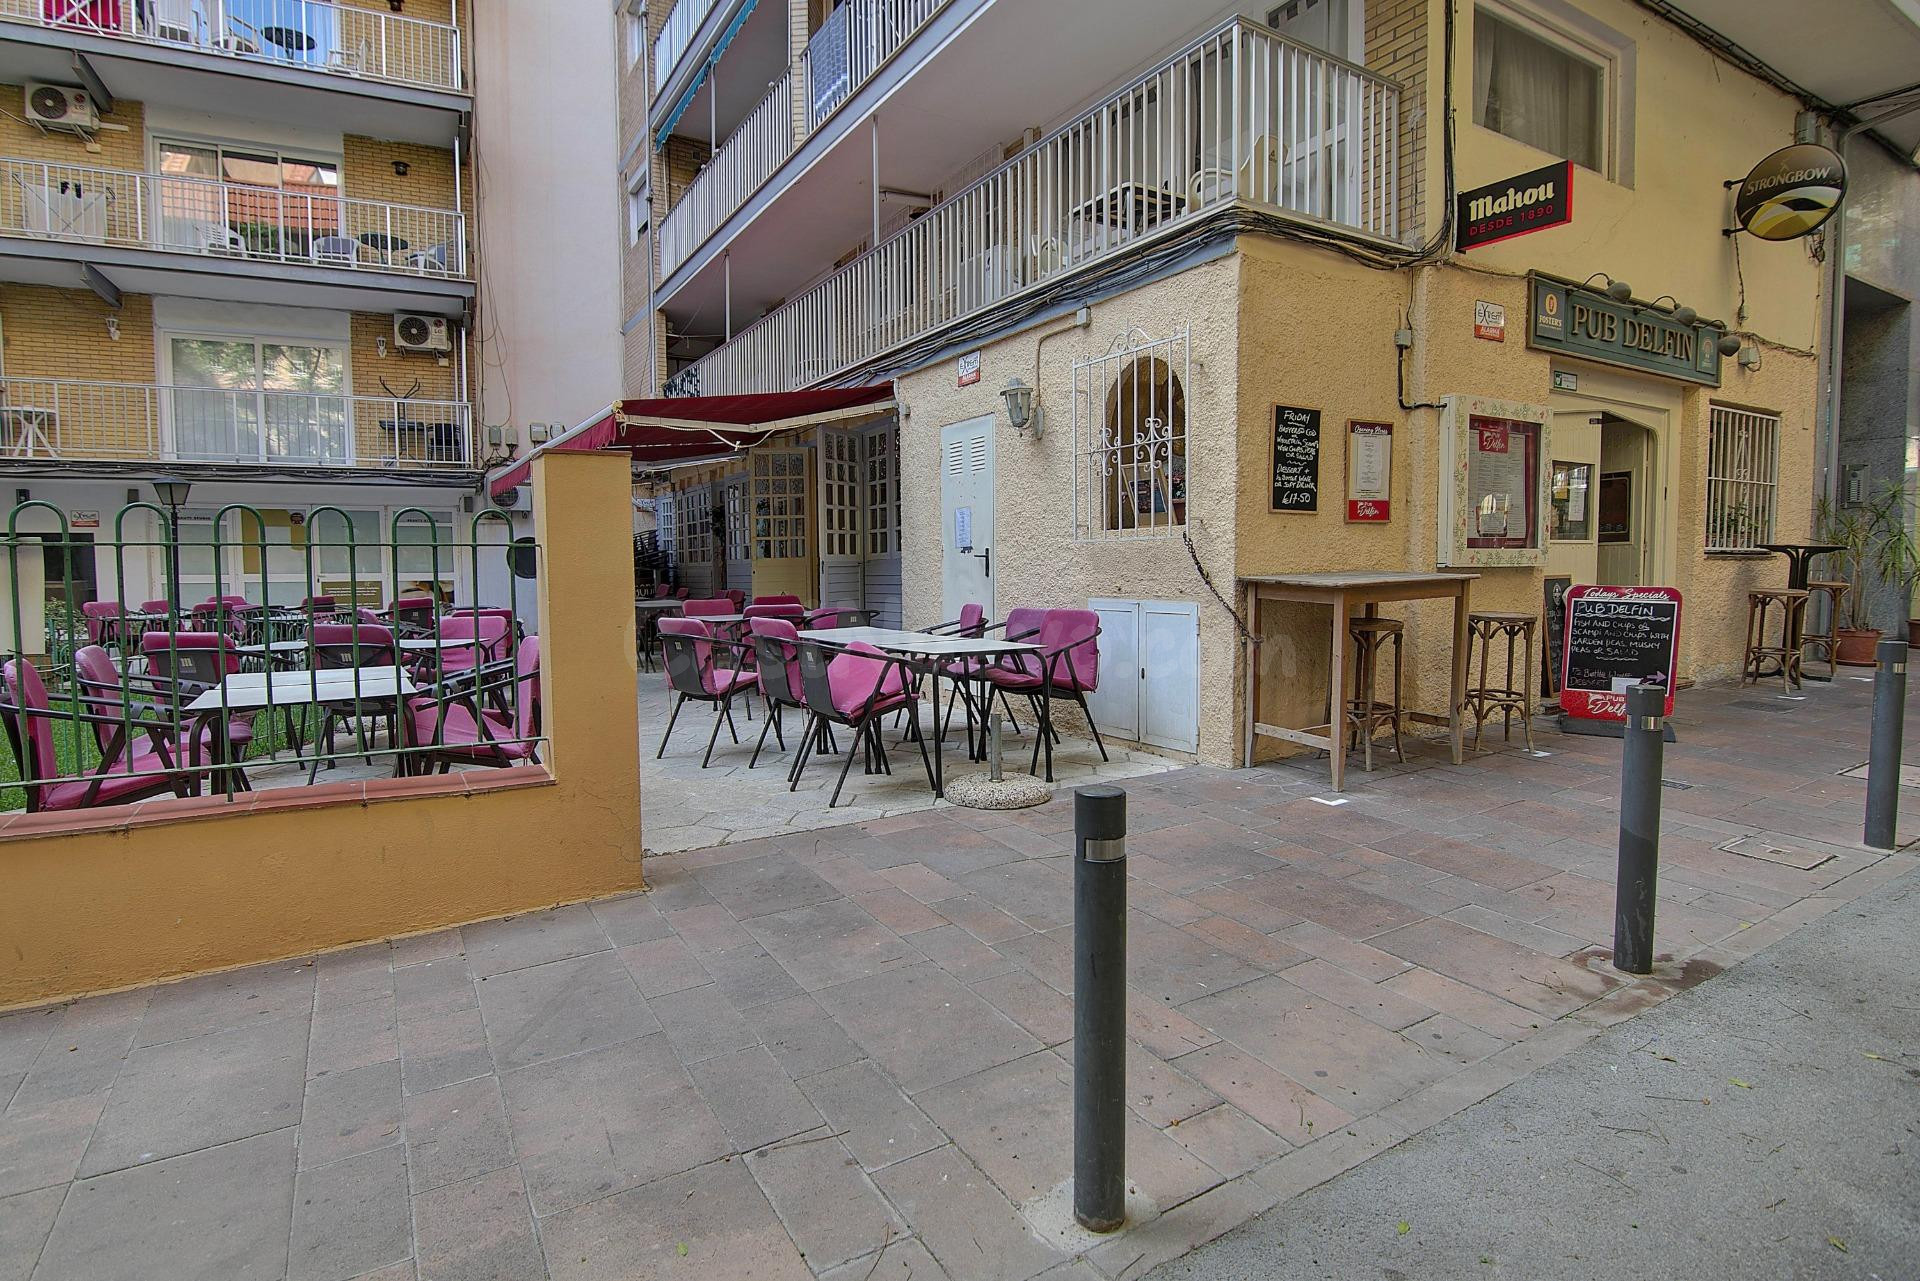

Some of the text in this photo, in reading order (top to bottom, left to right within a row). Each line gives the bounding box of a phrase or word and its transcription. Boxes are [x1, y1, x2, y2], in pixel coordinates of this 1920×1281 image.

[1746, 166, 1831, 196] STRONGBOW
[1469, 181, 1554, 221] Mahou
[1470, 205, 1553, 236] DESDE 1890
[1572, 304, 1693, 361] PUB DELFIN
[1283, 410, 1311, 424] FRIDAY
[1276, 463, 1304, 474] DESSERT
[1583, 587, 1670, 601] Todays Specials
[1576, 601, 1606, 614] PUB
[1592, 620, 1611, 628] AND
[1603, 629, 1622, 638] AND
[1623, 632, 1648, 640] CHIPS
[1571, 637, 1604, 646] GARDEN
[1629, 641, 1661, 650] MUSHY
[1571, 646, 1591, 654] PEAS
[1606, 695, 1625, 703] PUB
[1591, 700, 1626, 716] Delf
